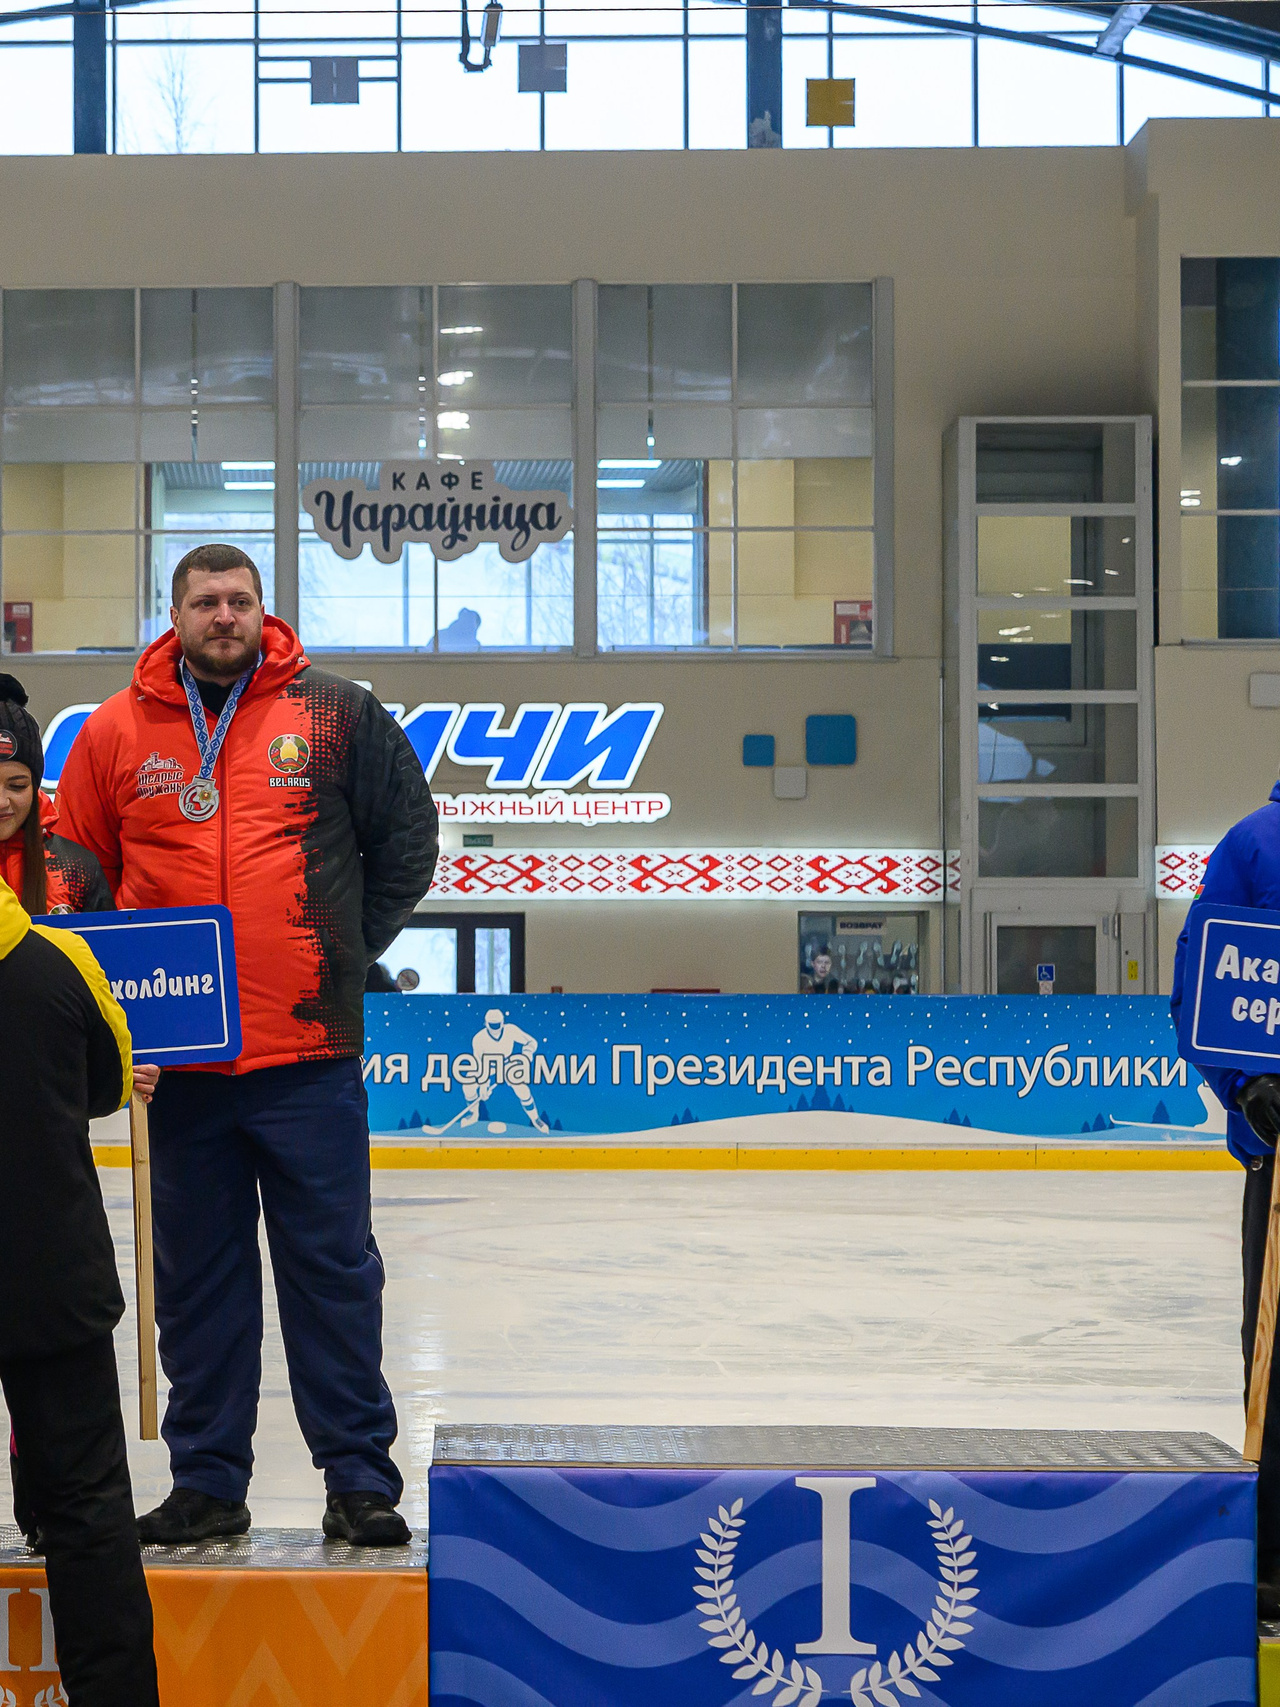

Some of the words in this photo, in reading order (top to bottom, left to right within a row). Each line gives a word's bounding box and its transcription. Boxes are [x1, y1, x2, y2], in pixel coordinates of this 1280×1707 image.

[392, 471, 483, 491] КАФЕ
[314, 489, 562, 552] Чараўніца
[269, 777, 311, 788] BELARUS
[573, 799, 664, 819] ЦЕНТР
[1215, 943, 1280, 985] Ака
[110, 967, 215, 1001] холдинг
[421, 1053, 596, 1092] делами
[611, 1043, 892, 1096] Президента
[907, 1043, 1187, 1099] Республики
[795, 1476, 877, 1655] I
